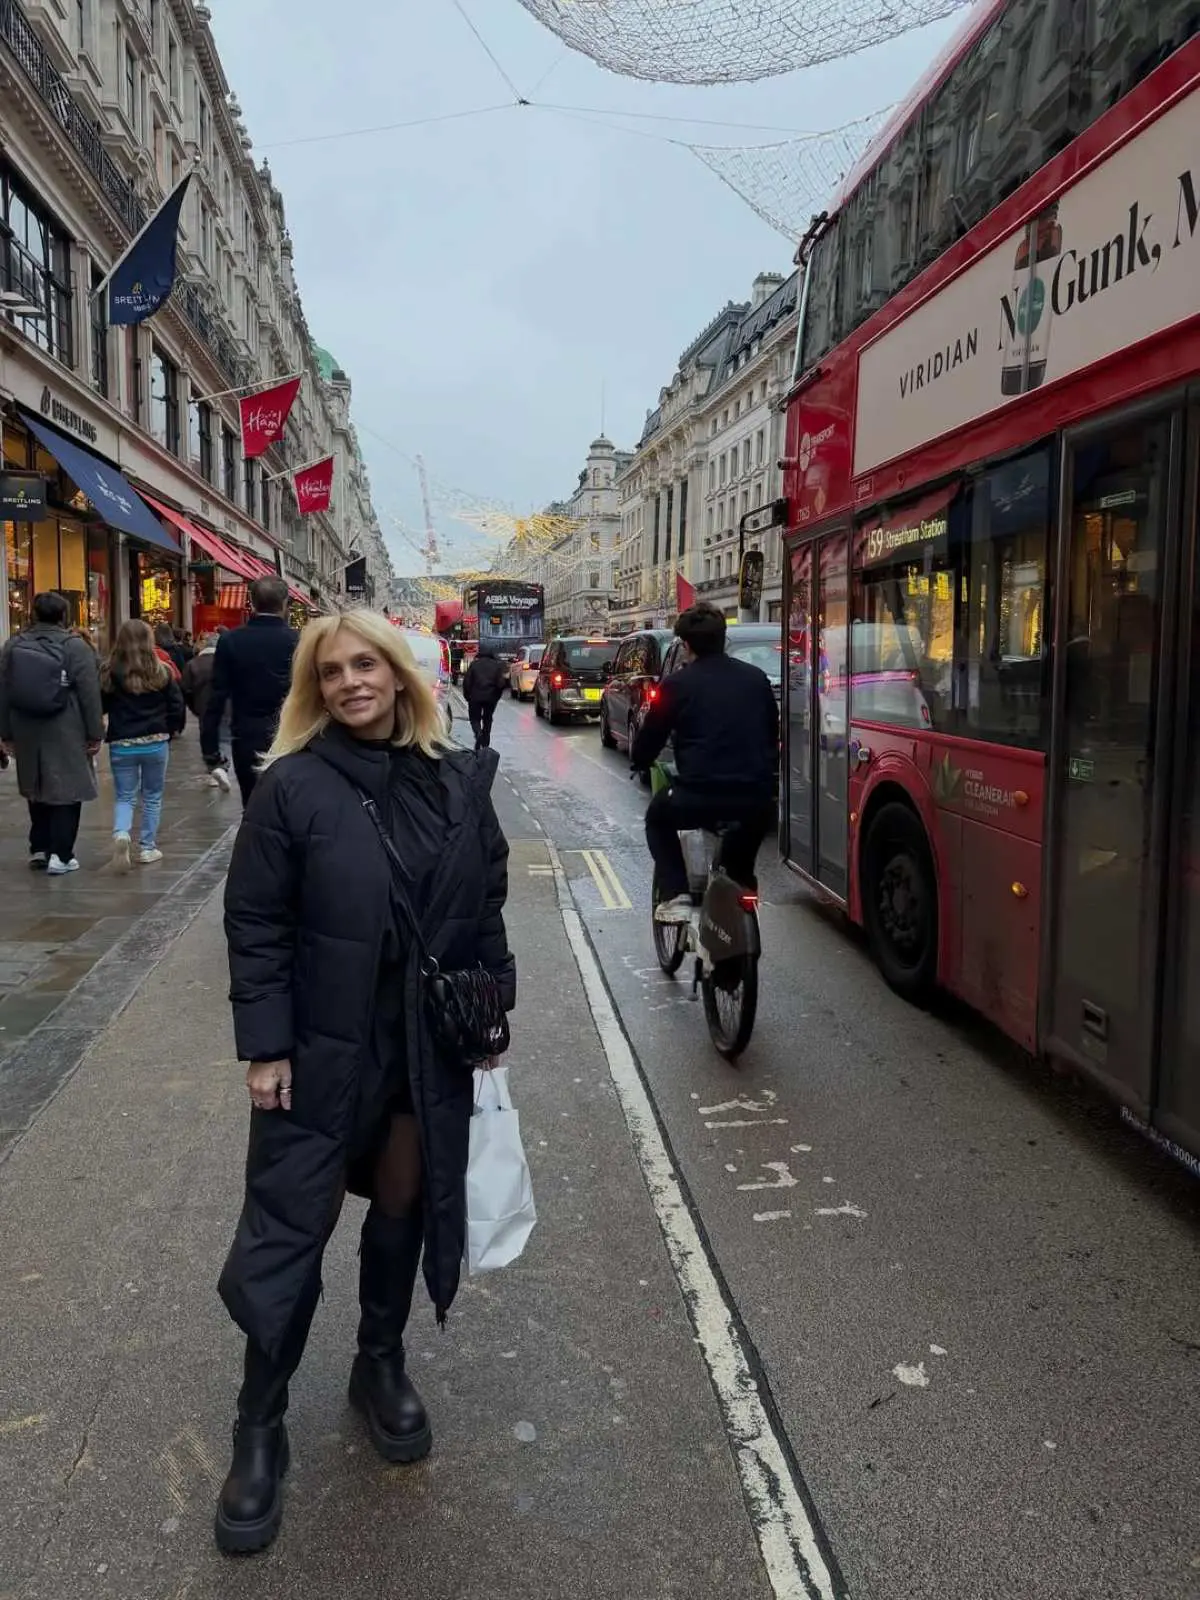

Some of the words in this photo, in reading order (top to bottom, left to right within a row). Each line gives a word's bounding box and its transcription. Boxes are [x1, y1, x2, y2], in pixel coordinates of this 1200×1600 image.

[1051, 201, 1161, 315] Gunk,
[900, 327, 978, 399] VIRIDIAN
[867, 527, 883, 559] 159
[920, 518, 947, 540] Station
[485, 595, 508, 604] ABBA
[509, 595, 539, 606] Voyage
